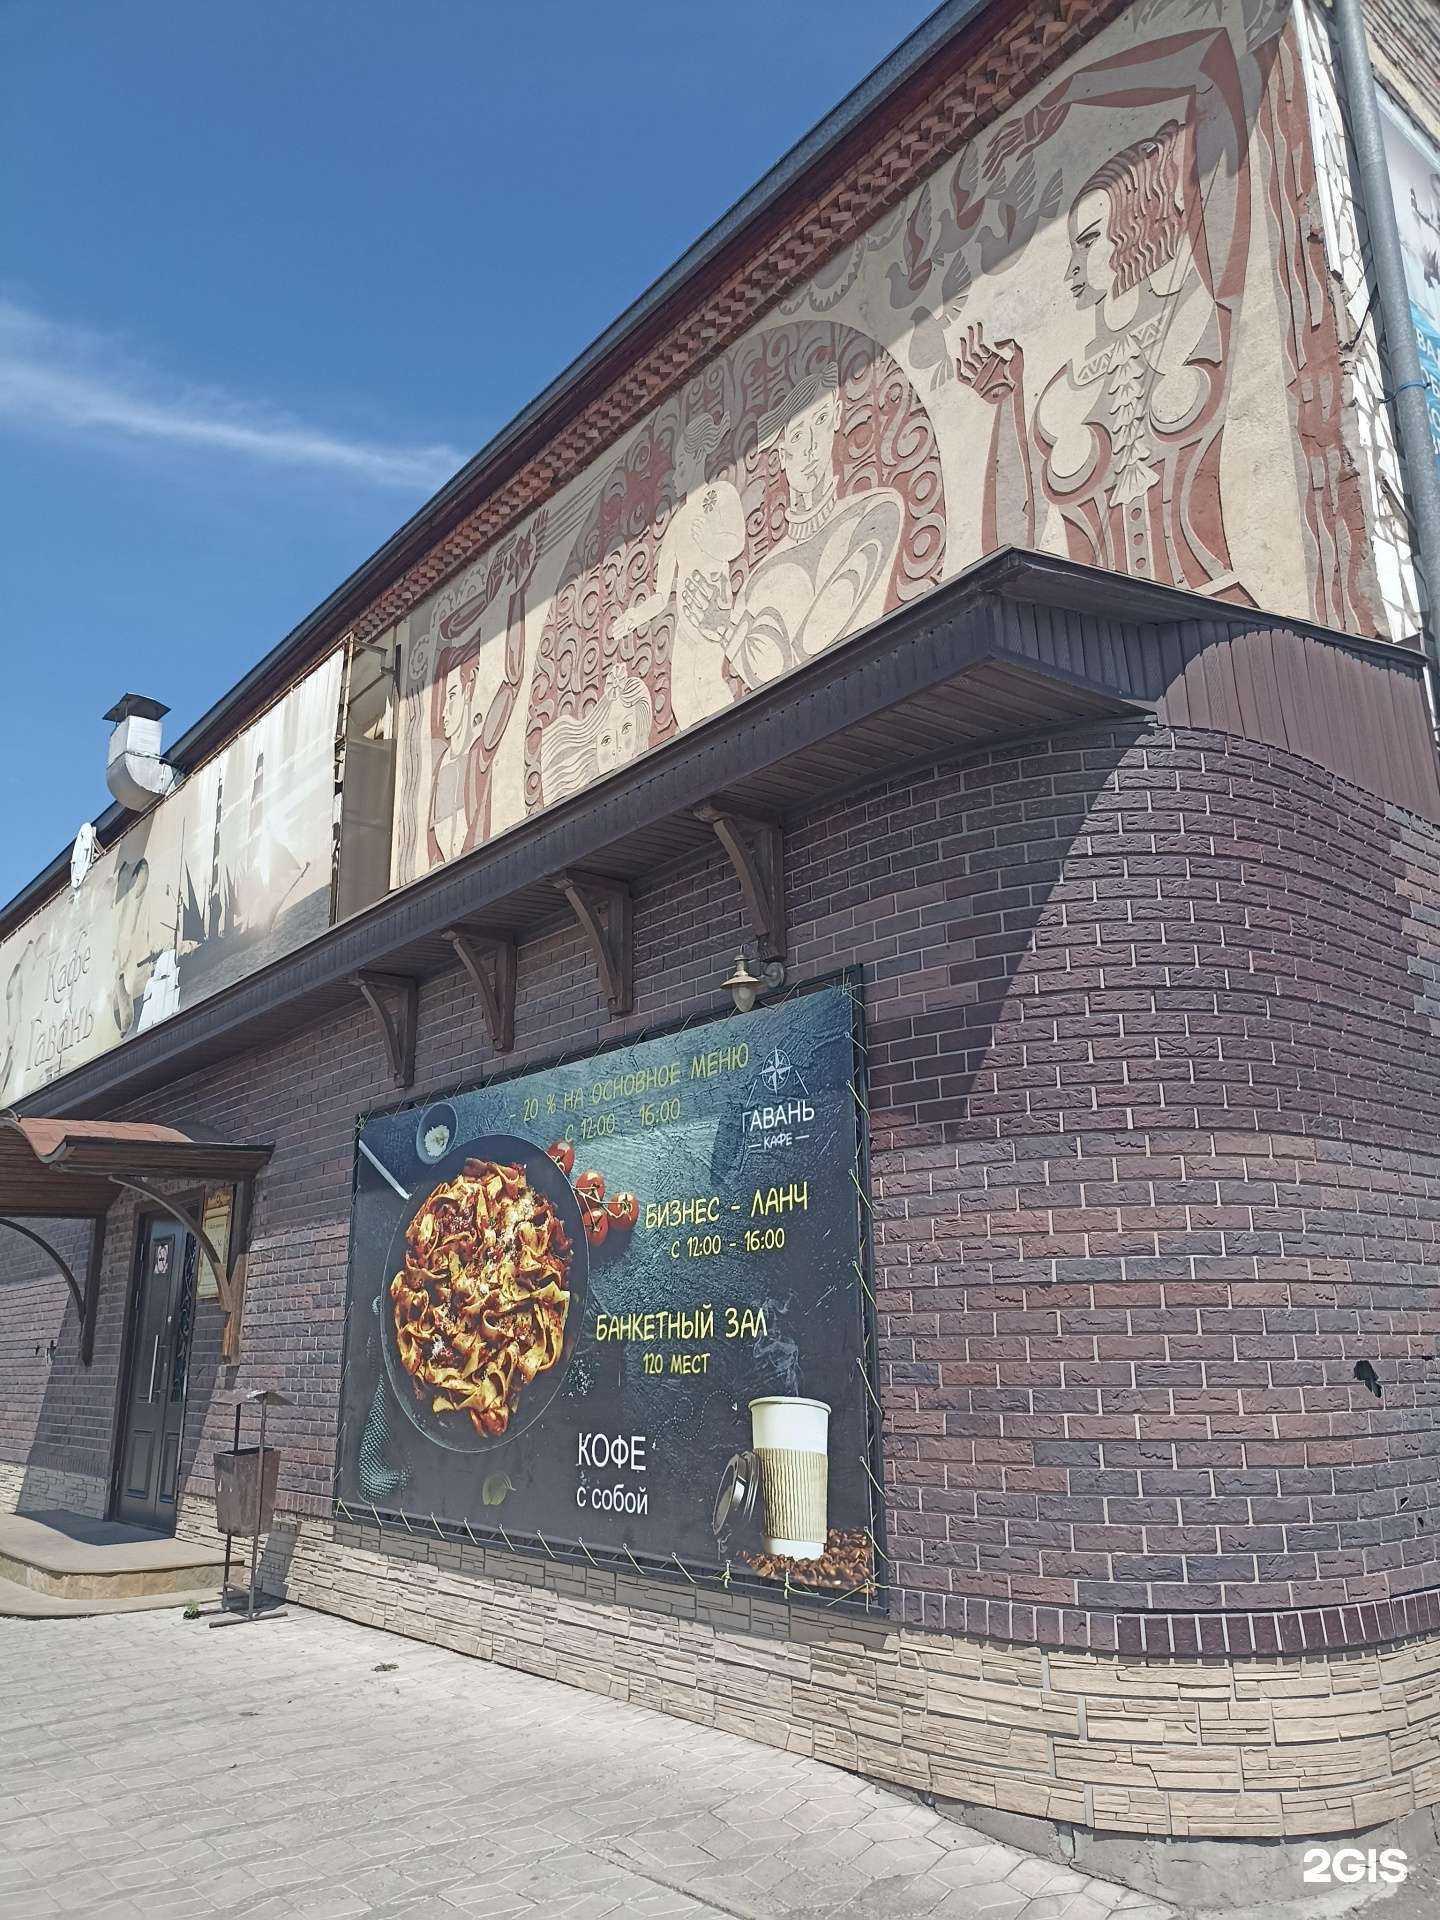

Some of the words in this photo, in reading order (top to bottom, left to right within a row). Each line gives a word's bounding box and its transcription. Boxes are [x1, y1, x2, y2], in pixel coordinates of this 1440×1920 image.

[523, 1099, 539, 1122] 20
[563, 1088, 584, 1111] НА
[592, 1062, 681, 1104] ОСНОВНОЕ
[690, 1042, 749, 1080] МЕНЮ
[580, 1113, 616, 1141] 12:00
[640, 1098, 681, 1127] 16:00
[742, 1100, 815, 1134] ГАВАНЬ
[763, 1133, 793, 1150] КАФЕ
[645, 1196, 720, 1230] БИЗНЕС
[751, 1181, 808, 1219] ЛАНЧ
[687, 1235, 722, 1258] 12:00
[746, 1227, 785, 1252] 16:00
[596, 1304, 714, 1342] БАНКЕТНЫЙ
[725, 1306, 768, 1338] ЗАЛ
[642, 1352, 664, 1375] 120
[670, 1352, 711, 1375] МЕСТ
[578, 1432, 646, 1471] КОФЕ
[591, 1484, 648, 1515] собой
